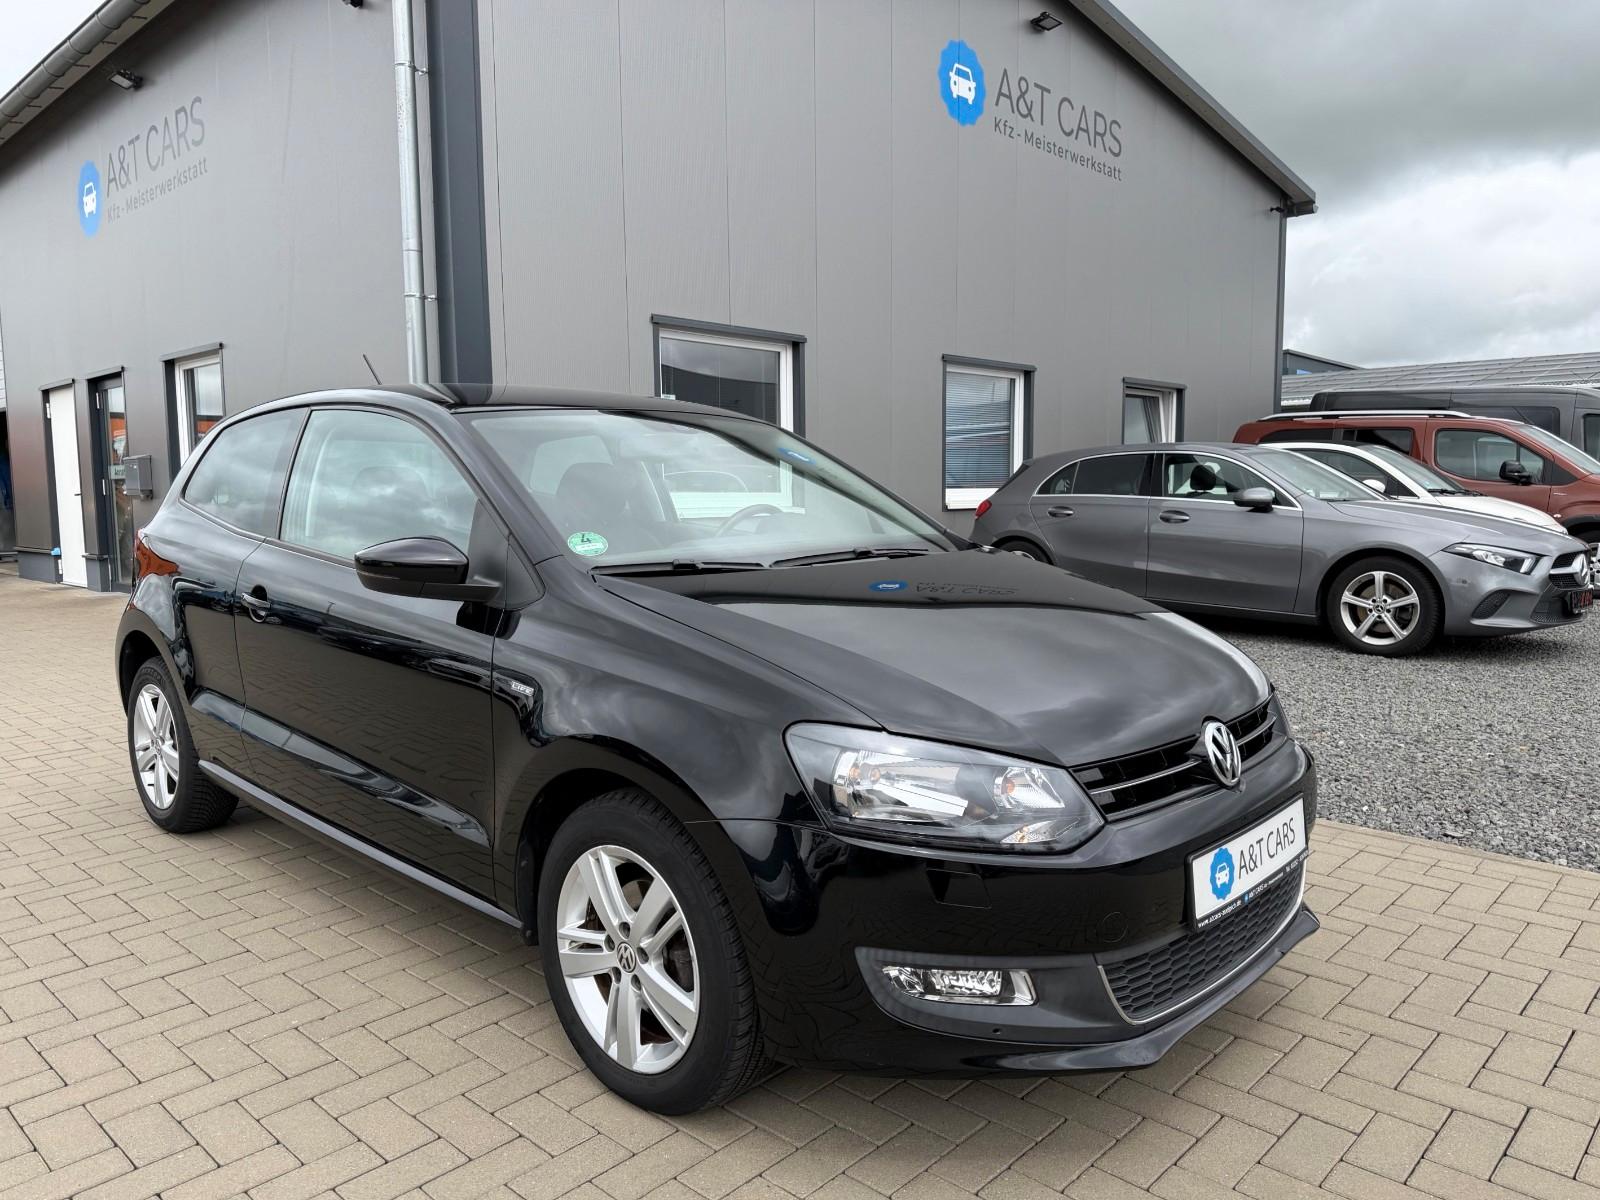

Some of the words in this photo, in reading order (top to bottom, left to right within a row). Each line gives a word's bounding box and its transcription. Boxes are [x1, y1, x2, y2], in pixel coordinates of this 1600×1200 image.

[107, 134, 140, 199] A&T
[146, 96, 205, 172] CARS
[995, 67, 1051, 126] A&T
[1057, 96, 1122, 158] CARS
[1239, 837, 1264, 880] A&T
[1266, 817, 1296, 859] CARS
